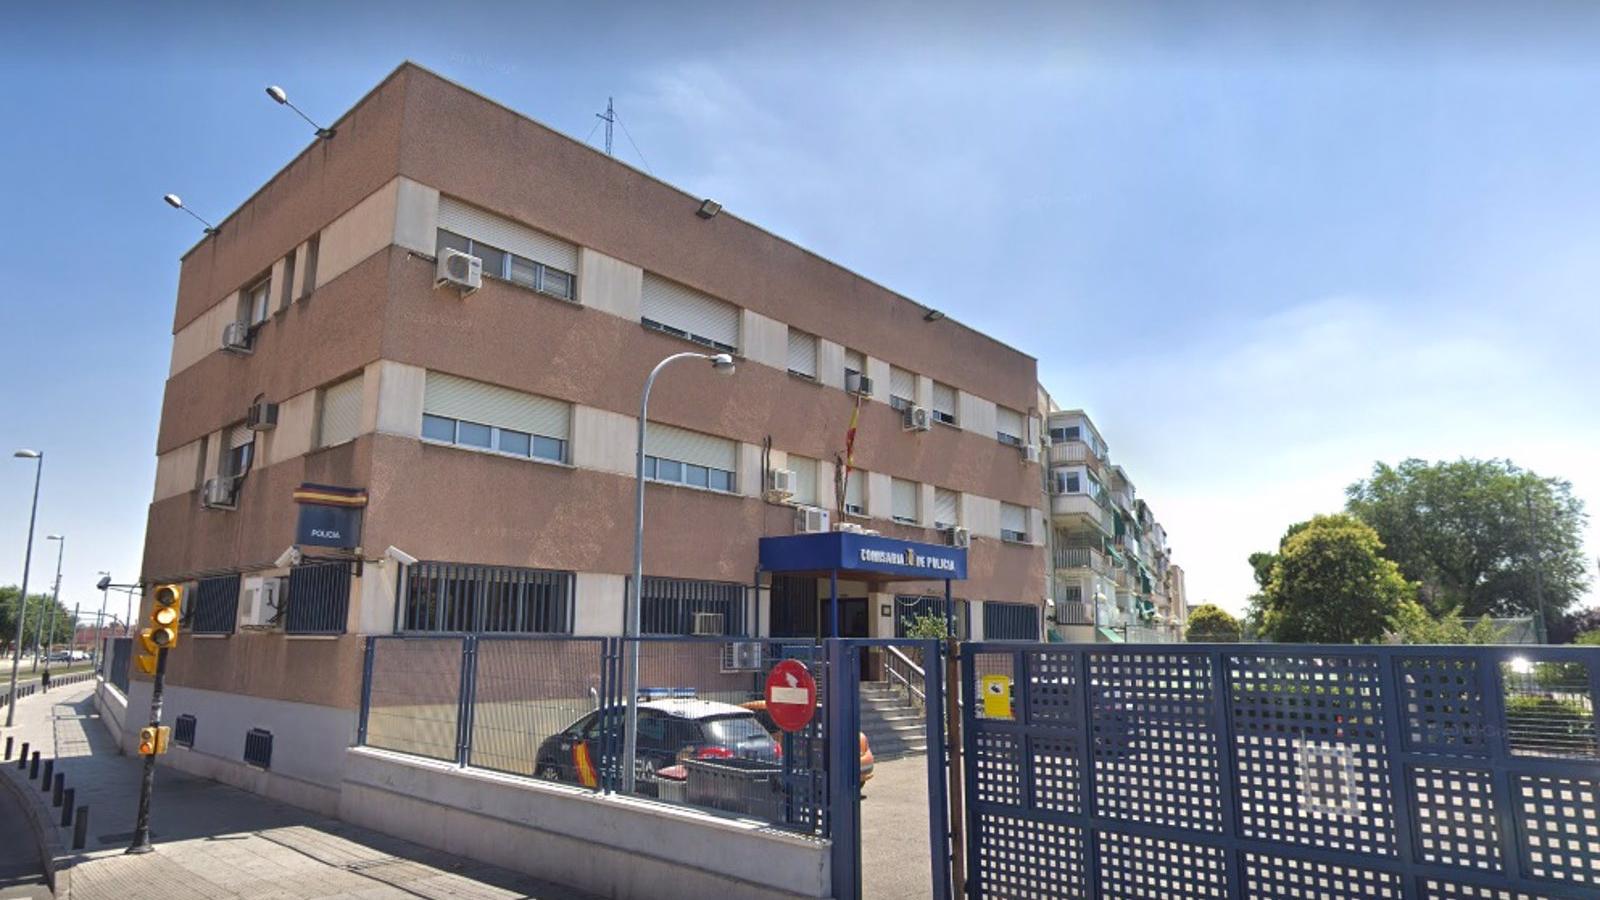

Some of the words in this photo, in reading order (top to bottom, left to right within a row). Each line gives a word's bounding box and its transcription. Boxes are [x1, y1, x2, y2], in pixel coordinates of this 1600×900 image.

[861, 548, 905, 565] COMISARIA
[917, 556, 926, 568] DE
[927, 557, 955, 571] POLICIA
